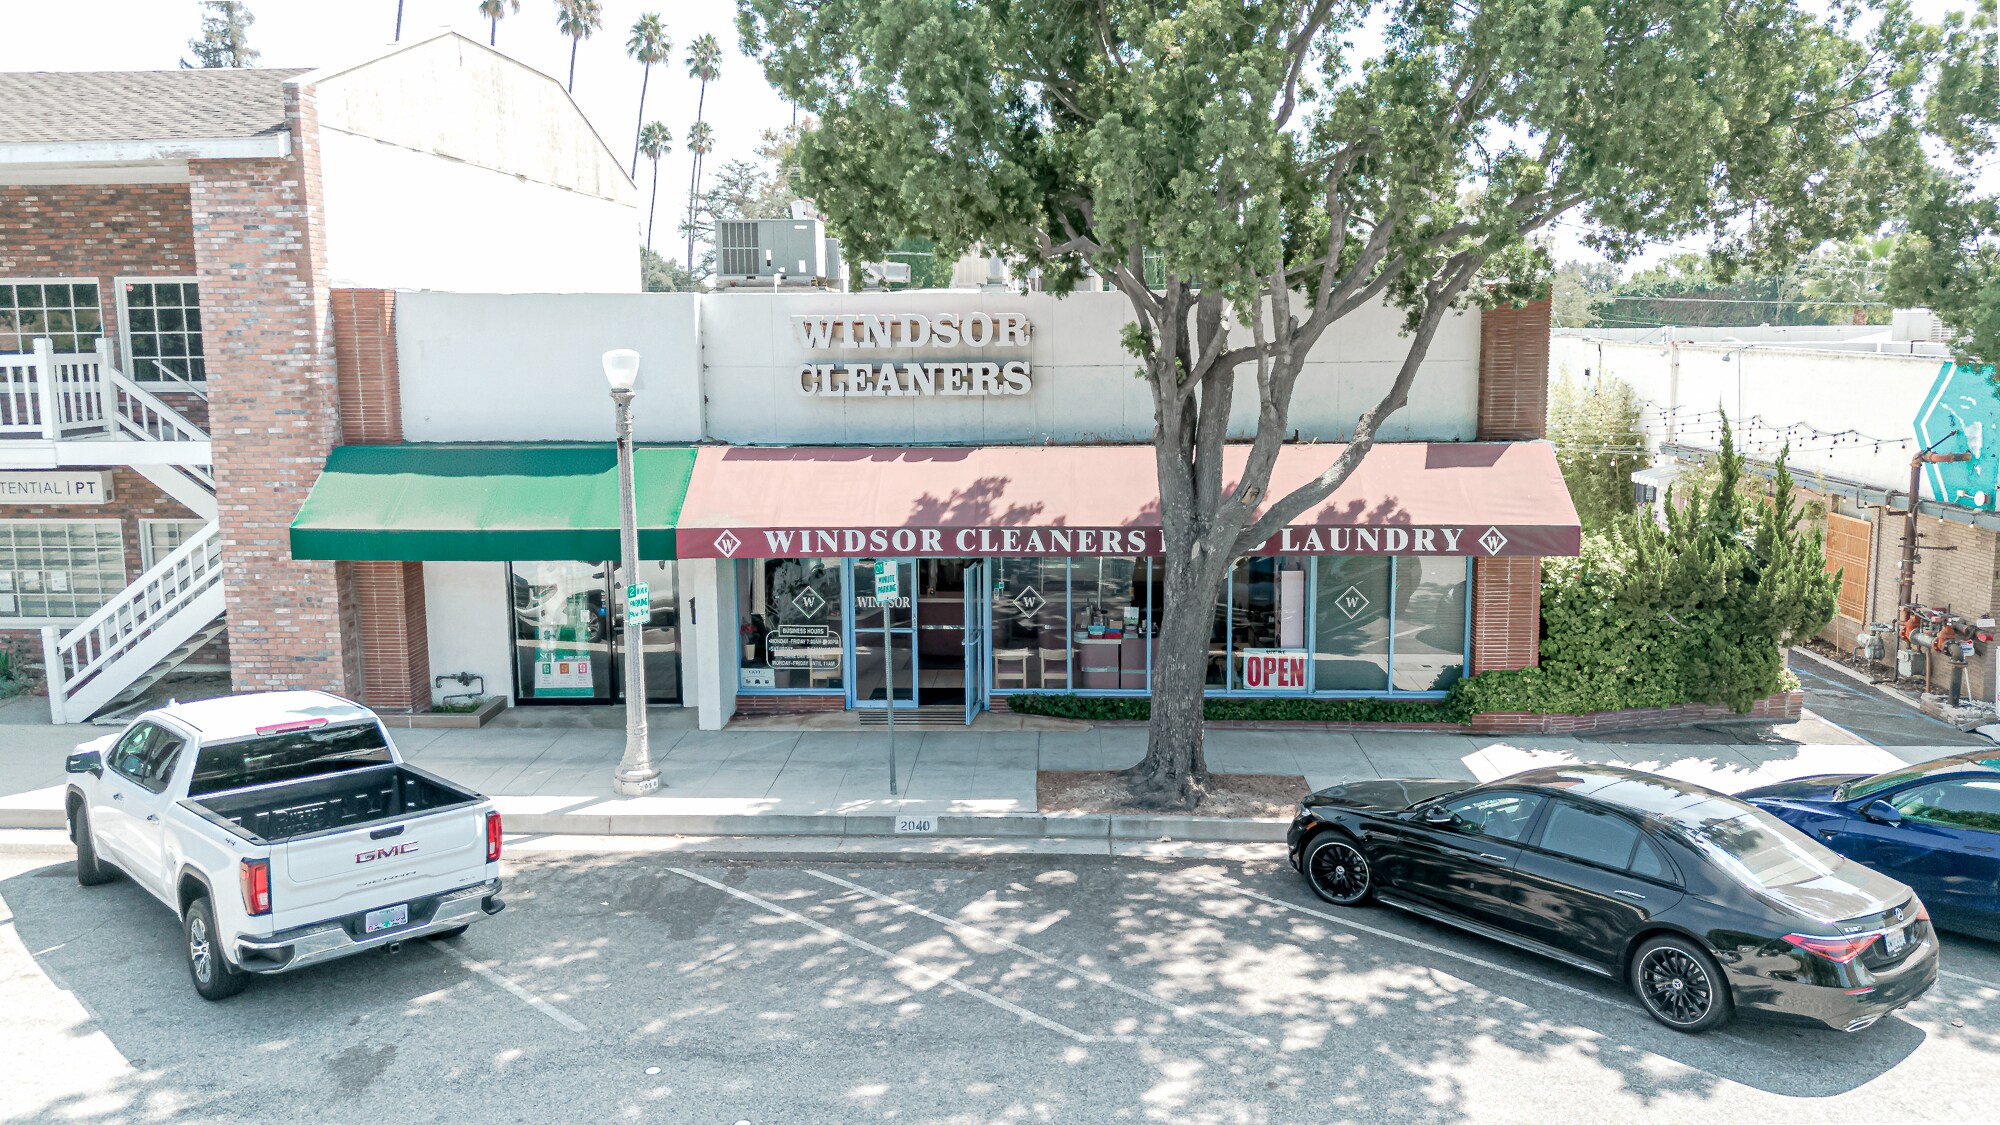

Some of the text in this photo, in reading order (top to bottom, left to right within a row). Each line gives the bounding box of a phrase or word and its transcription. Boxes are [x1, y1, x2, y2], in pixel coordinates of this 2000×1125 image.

[790, 311, 1031, 349] WINDSOR
[799, 361, 1032, 397] CLEANERS
[0, 481, 96, 494] TENTIAL PT
[763, 528, 944, 553] WINDSOR
[956, 528, 1147, 553] CLEANERS
[1279, 527, 1464, 552] LAUNDRY
[878, 584, 896, 594] PARKING
[857, 596, 910, 608] WINSOR
[1247, 655, 1304, 687] OPEN
[901, 820, 930, 831] 2040
[355, 840, 419, 863] GMC
